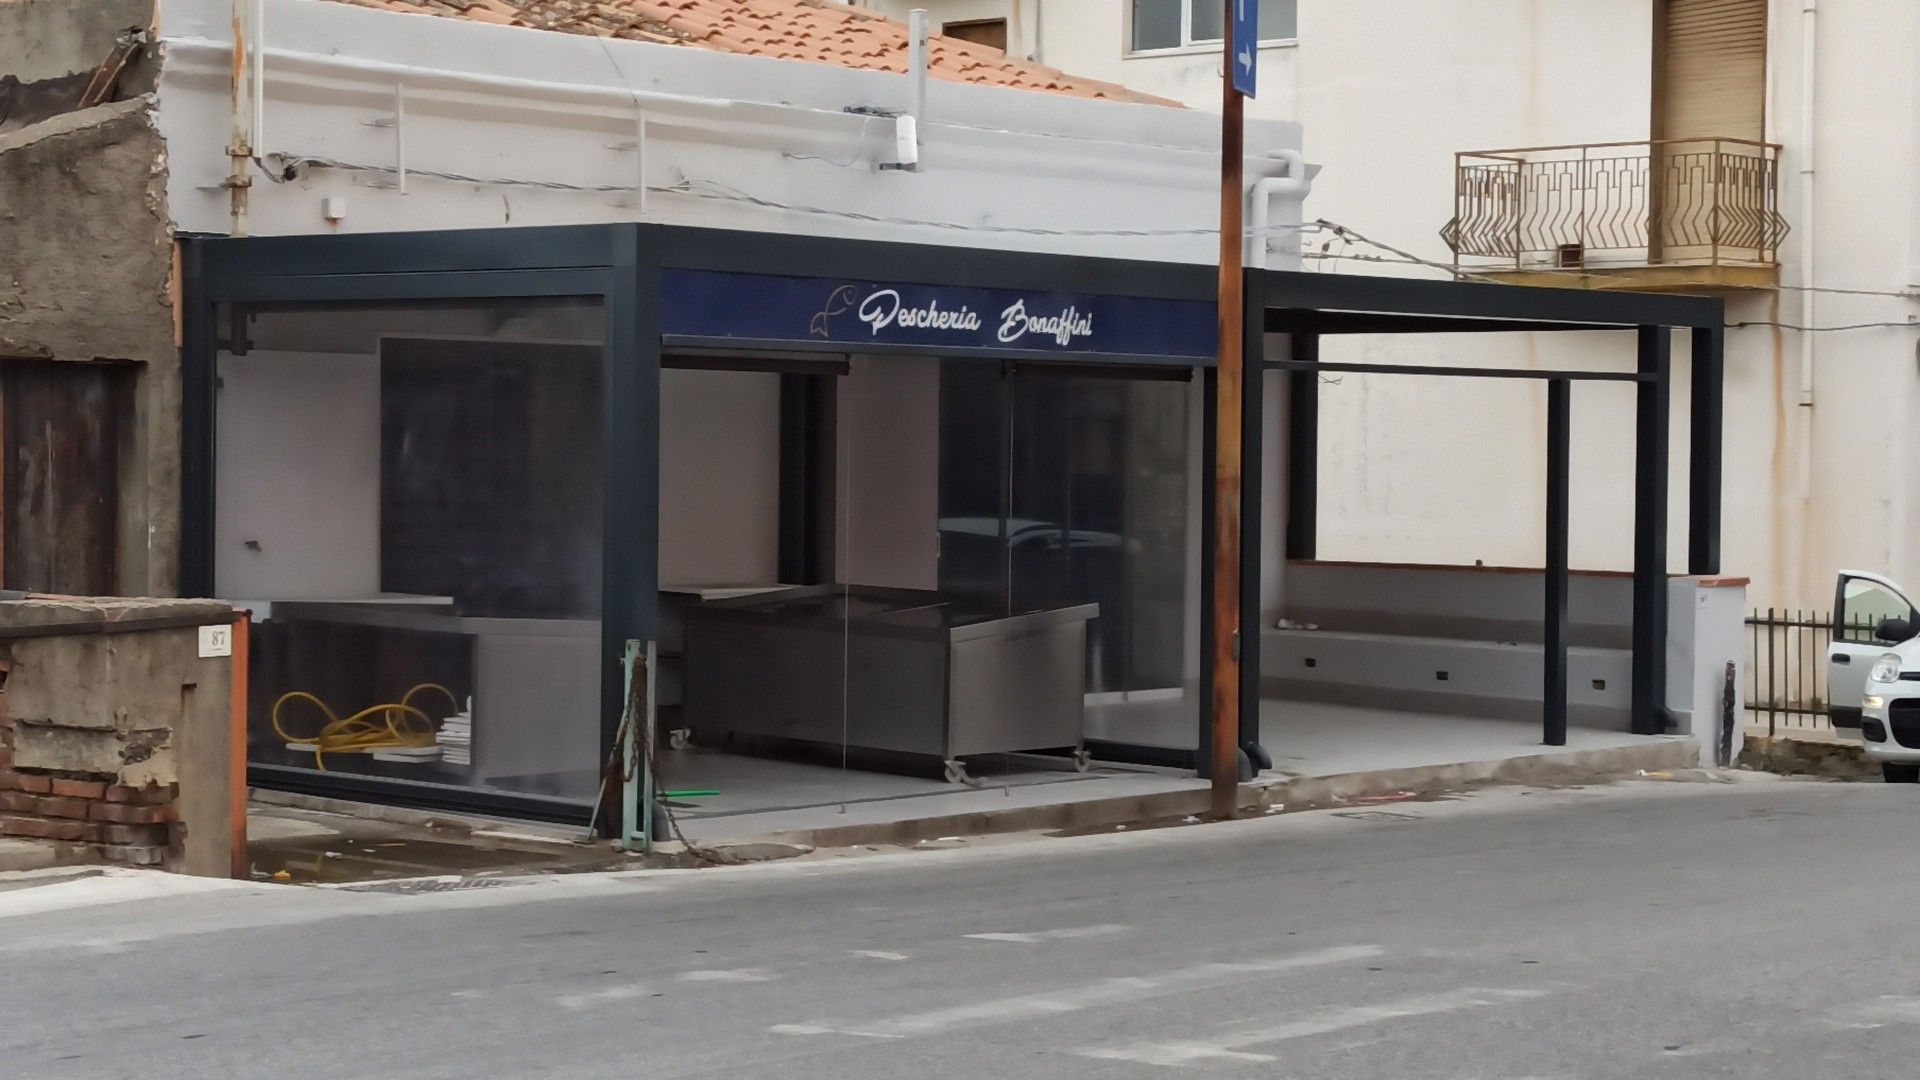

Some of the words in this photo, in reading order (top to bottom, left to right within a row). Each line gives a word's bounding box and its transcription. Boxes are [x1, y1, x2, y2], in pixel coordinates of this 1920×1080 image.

[859, 289, 981, 336] Pescheria
[997, 298, 1092, 346] Bonaffini
[211, 630, 226, 646] 87
